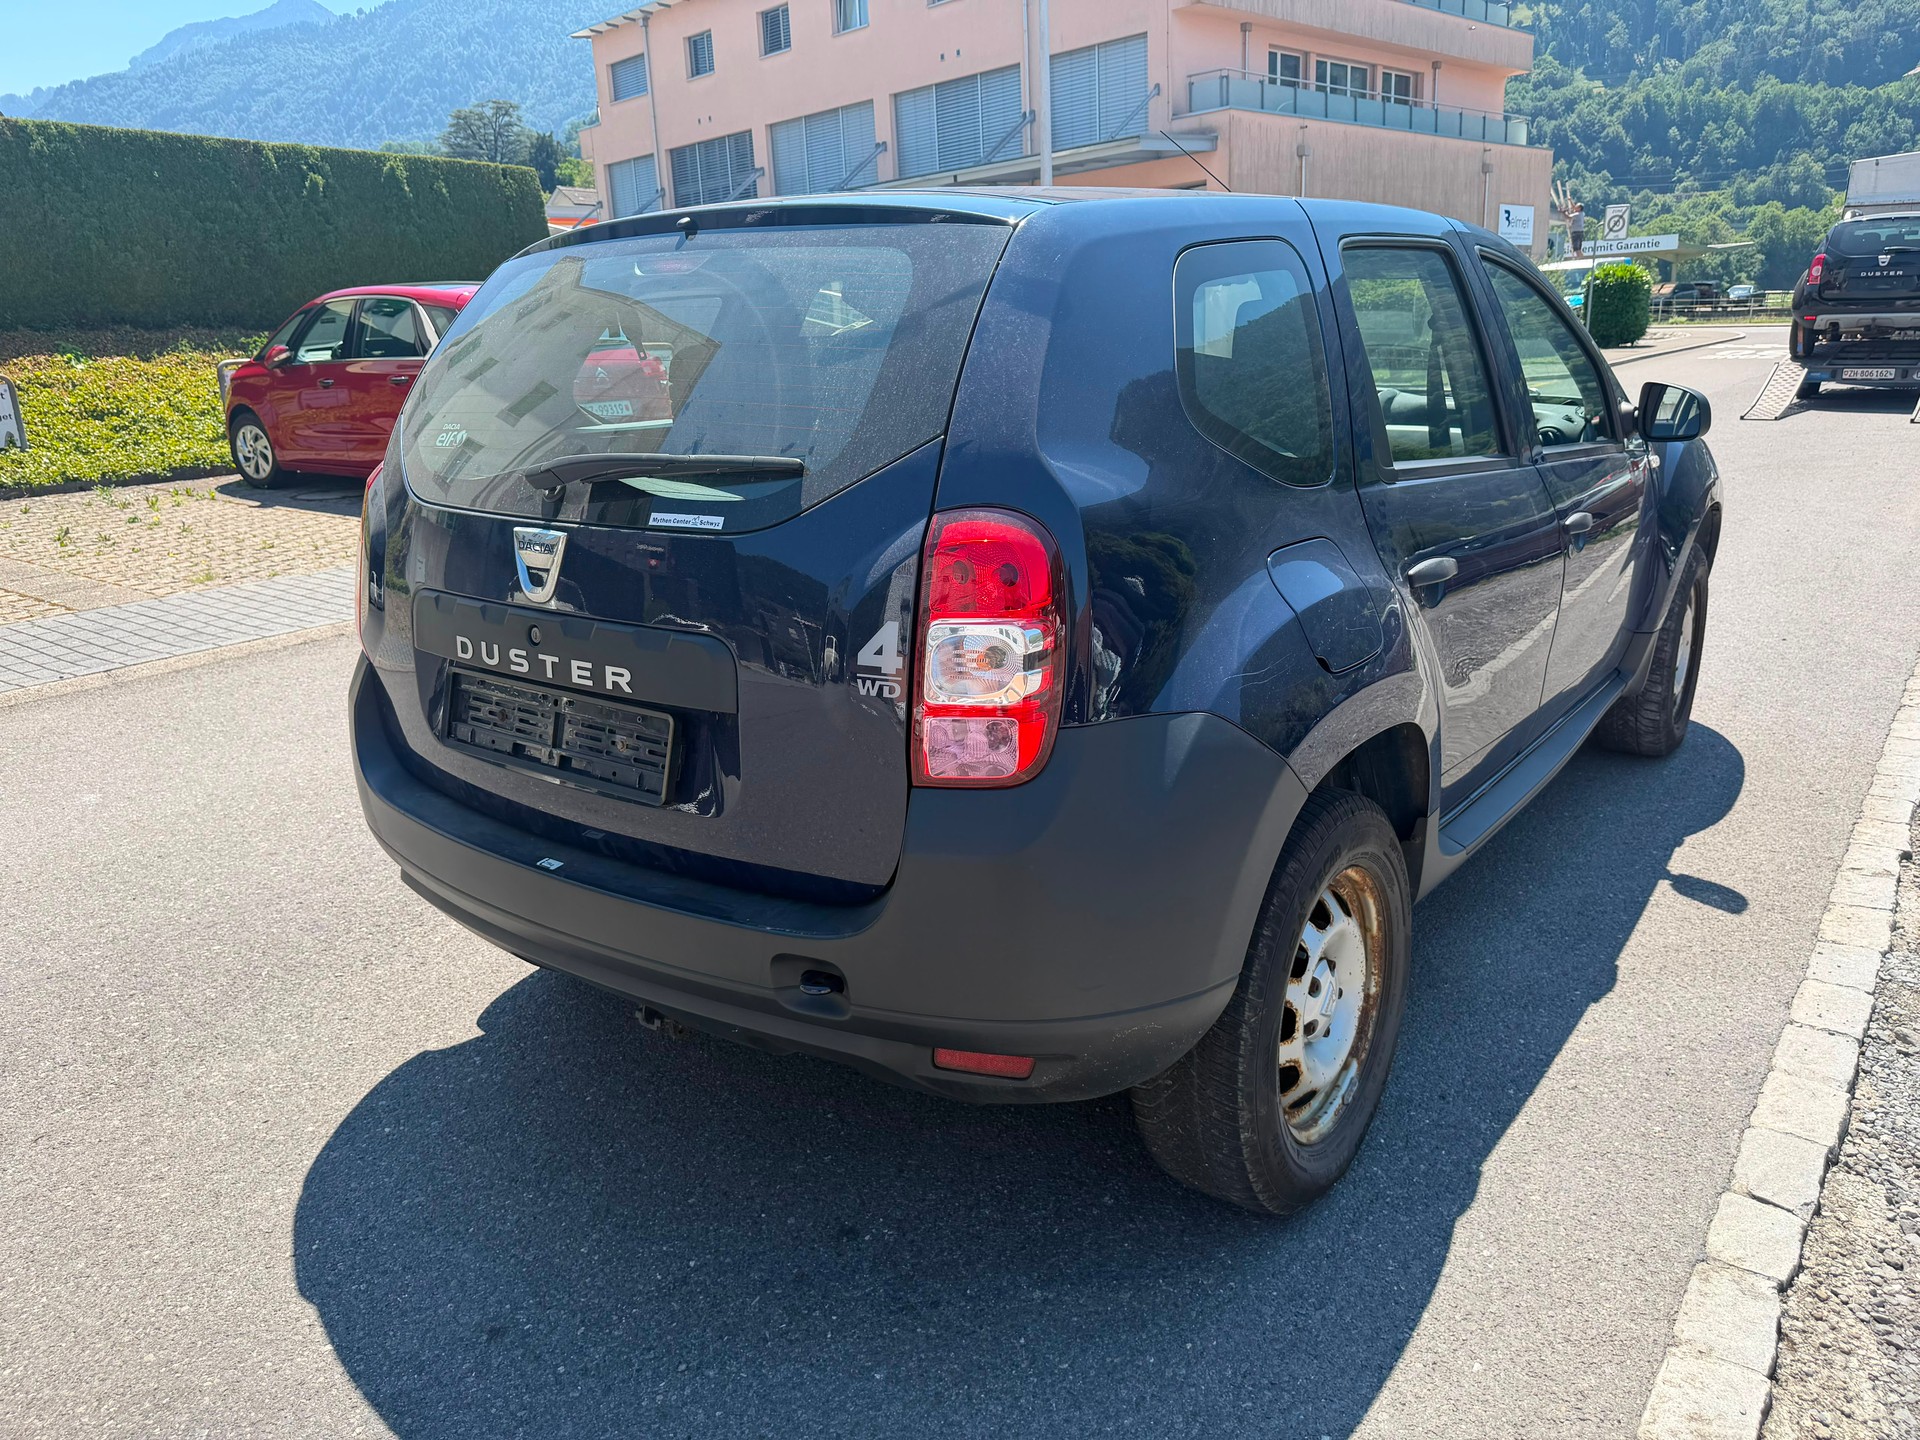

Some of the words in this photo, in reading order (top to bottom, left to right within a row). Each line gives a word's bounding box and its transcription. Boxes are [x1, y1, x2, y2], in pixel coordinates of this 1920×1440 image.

[1596, 244, 1613, 252] mit
[1616, 240, 1661, 251] Garantie
[436, 431, 458, 446] elf
[672, 517, 691, 525] Center
[699, 519, 720, 527] Schwyz
[518, 540, 552, 554] DACIA
[856, 620, 903, 674] 4
[455, 635, 633, 693] DUSTER
[856, 678, 901, 698] WD
